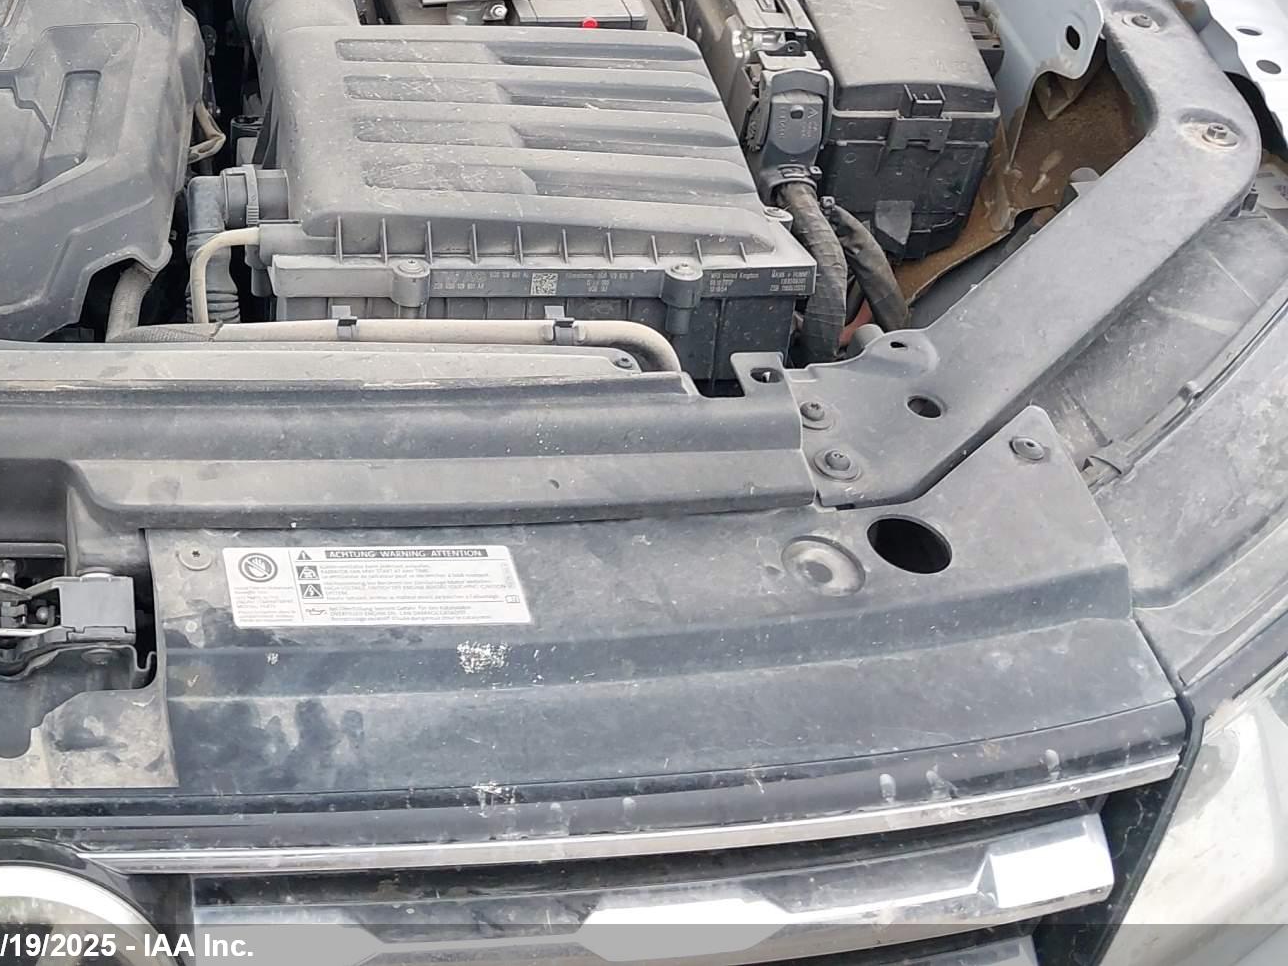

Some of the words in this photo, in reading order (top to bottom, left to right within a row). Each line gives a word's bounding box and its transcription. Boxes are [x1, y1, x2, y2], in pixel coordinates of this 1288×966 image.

[329, 550, 375, 558] ACHTUNG
[380, 550, 426, 558] WARNING
[431, 549, 482, 557] ATTENTION
